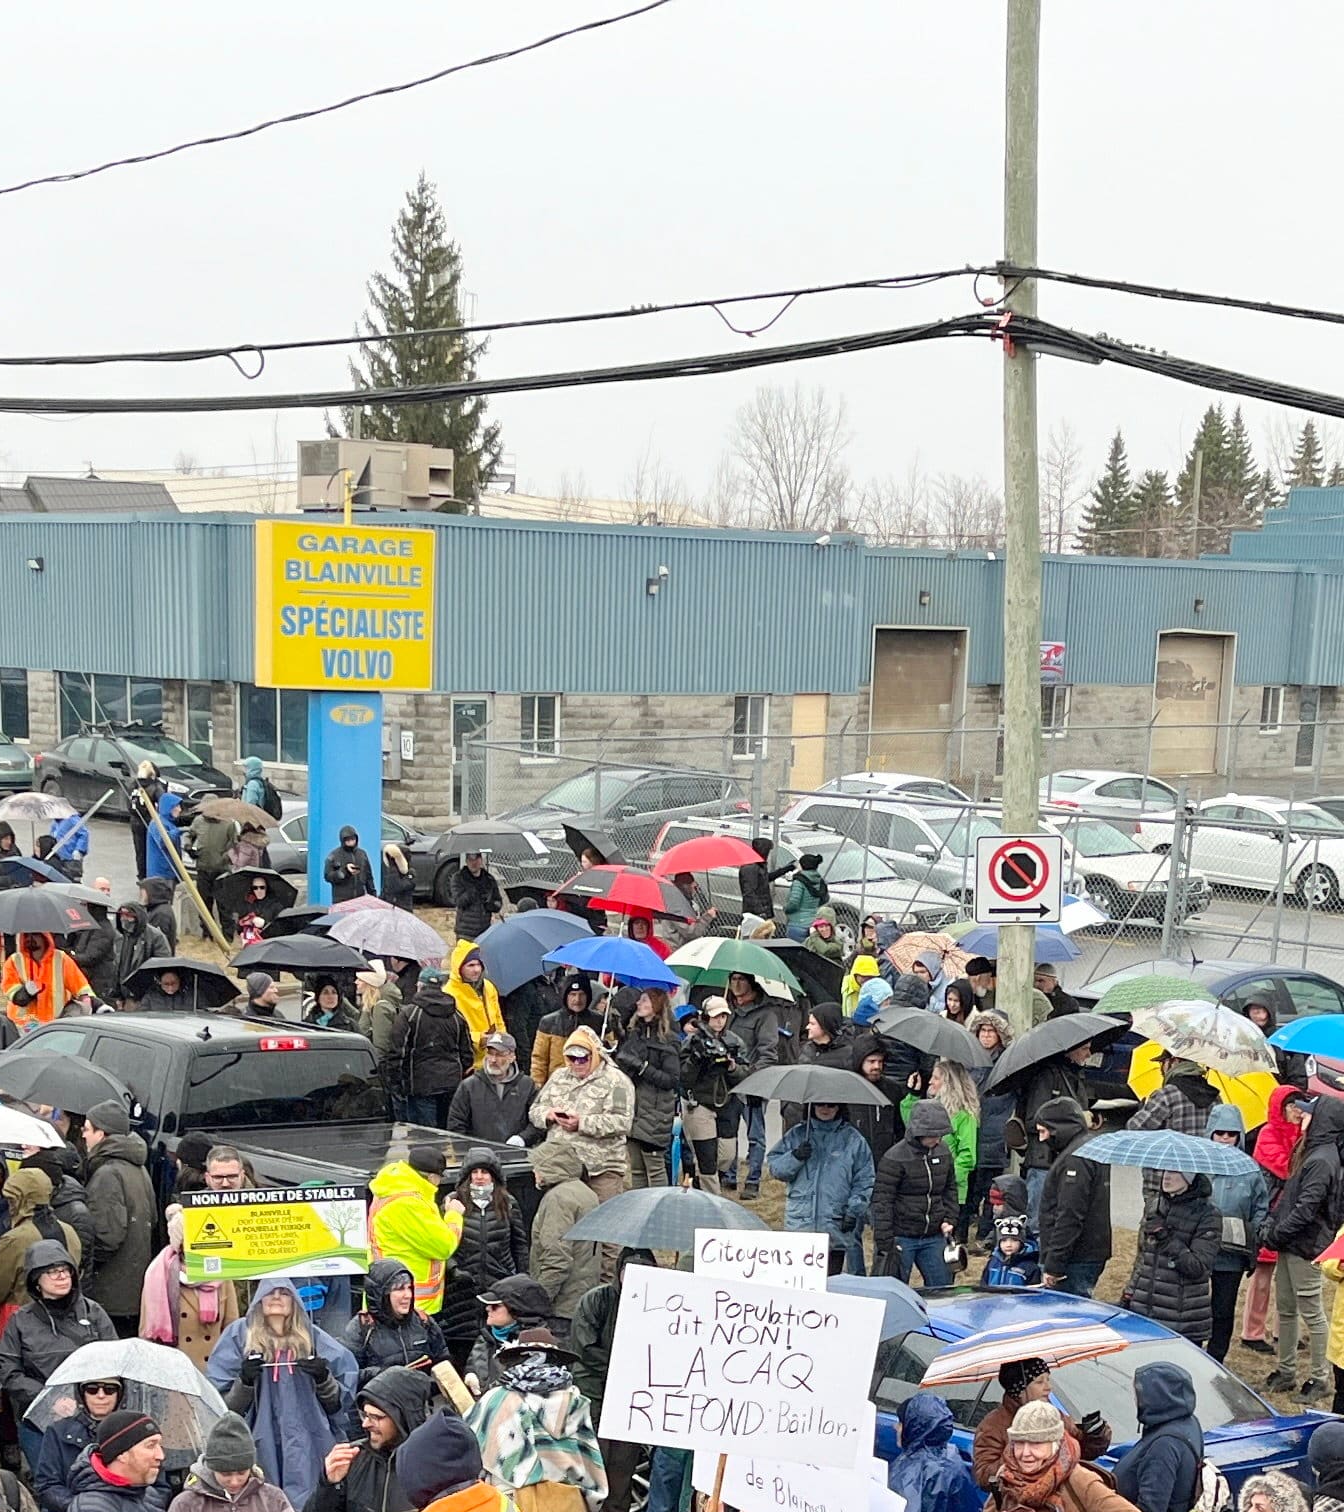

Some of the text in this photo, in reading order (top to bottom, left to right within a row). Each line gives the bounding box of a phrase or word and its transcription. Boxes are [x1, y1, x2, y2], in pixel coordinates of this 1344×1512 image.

[297, 534, 413, 557] GARAGE
[285, 560, 422, 587] BLAINVILLE
[280, 600, 424, 640] SPÉCIALISTE
[321, 648, 392, 680] VOLVO
[192, 1187, 356, 1205] NON AU PROJET DE STABLEX
[701, 1238, 825, 1278] Citoyens de
[668, 1315, 702, 1336] dit
[648, 1344, 814, 1392] LA CAQ
[746, 1460, 764, 1489] de
